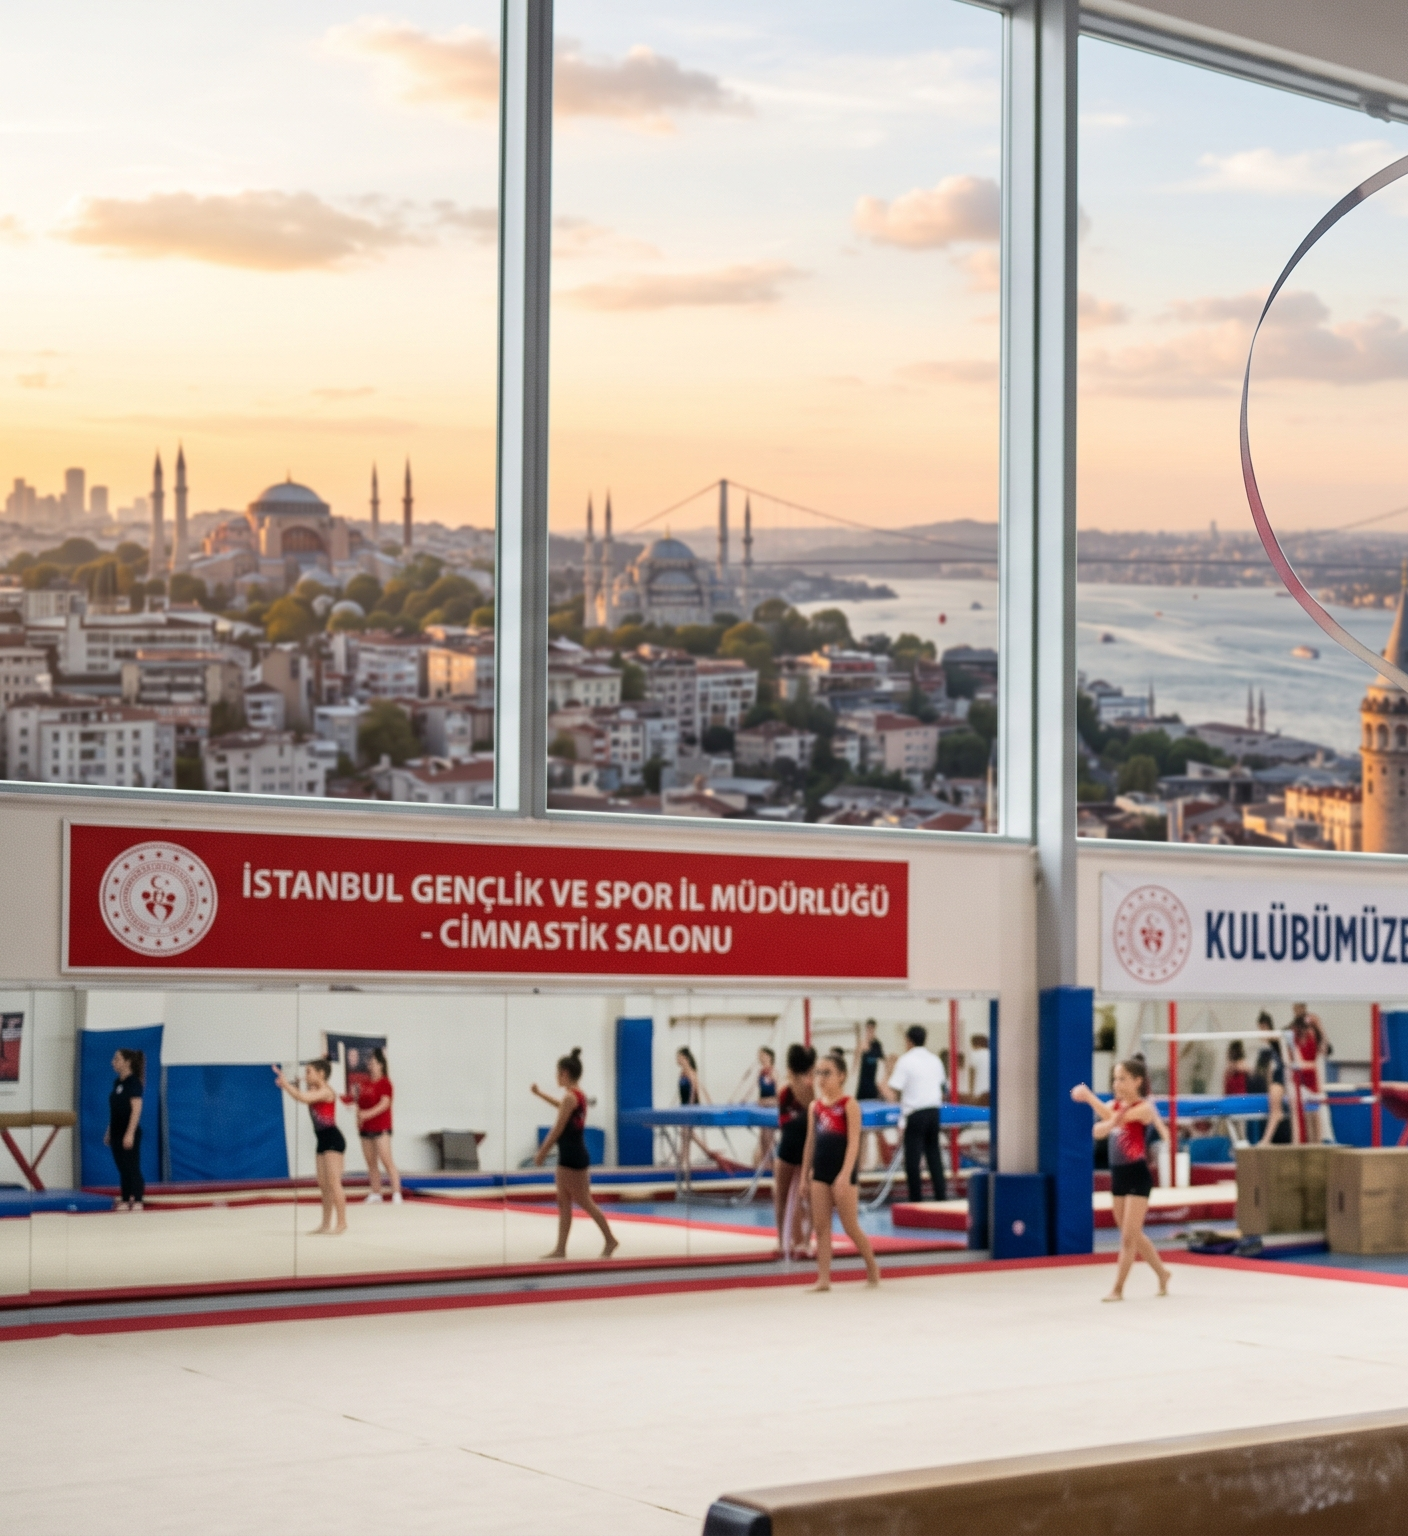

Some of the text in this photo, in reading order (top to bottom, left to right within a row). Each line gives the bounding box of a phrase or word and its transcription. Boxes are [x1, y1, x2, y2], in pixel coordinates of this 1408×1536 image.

[242, 861, 404, 903] İSTANBUL
[411, 870, 544, 914] GENÇLİK
[550, 878, 588, 908] VE
[595, 879, 673, 910] SPOR
[680, 876, 705, 912] İL
[711, 878, 890, 918] MÜDÜRLÜĞÜ
[439, 912, 609, 951] CİMNASTİK
[615, 922, 733, 955] SALONU
